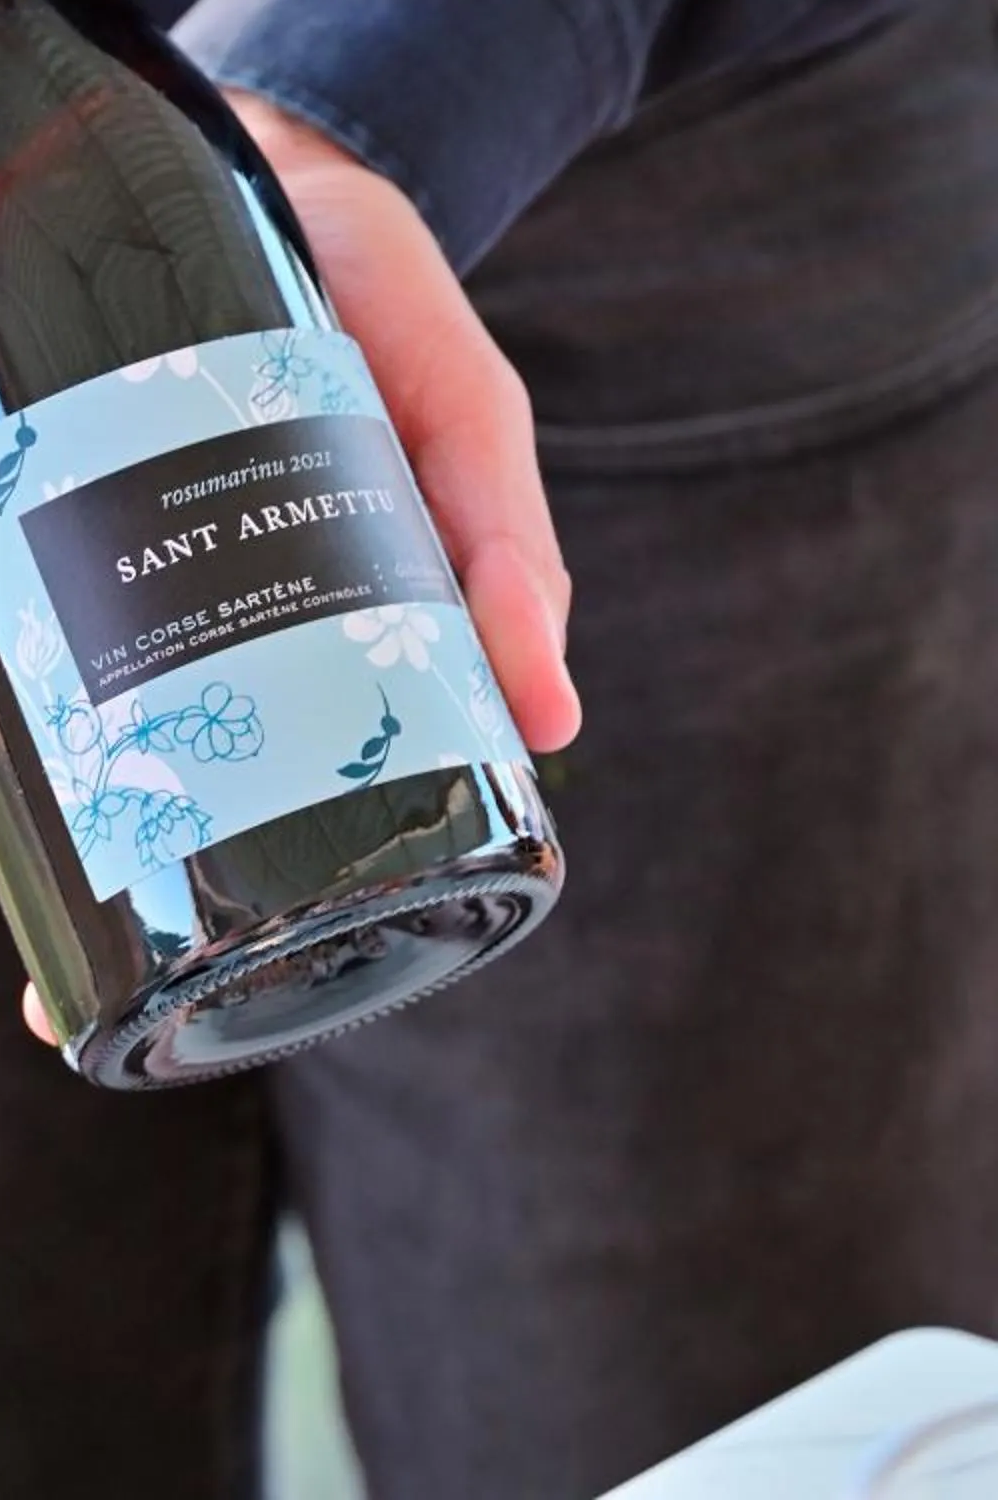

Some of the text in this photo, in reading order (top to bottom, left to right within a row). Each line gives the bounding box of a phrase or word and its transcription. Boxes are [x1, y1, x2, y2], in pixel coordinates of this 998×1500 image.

[161, 451, 332, 509] rosumarinu 2021
[116, 488, 395, 583] SANT ARMETTU
[91, 644, 128, 671] VIN
[135, 609, 211, 651] CORSE
[99, 641, 185, 687] APPELLATION
[189, 622, 235, 647] CORSE
